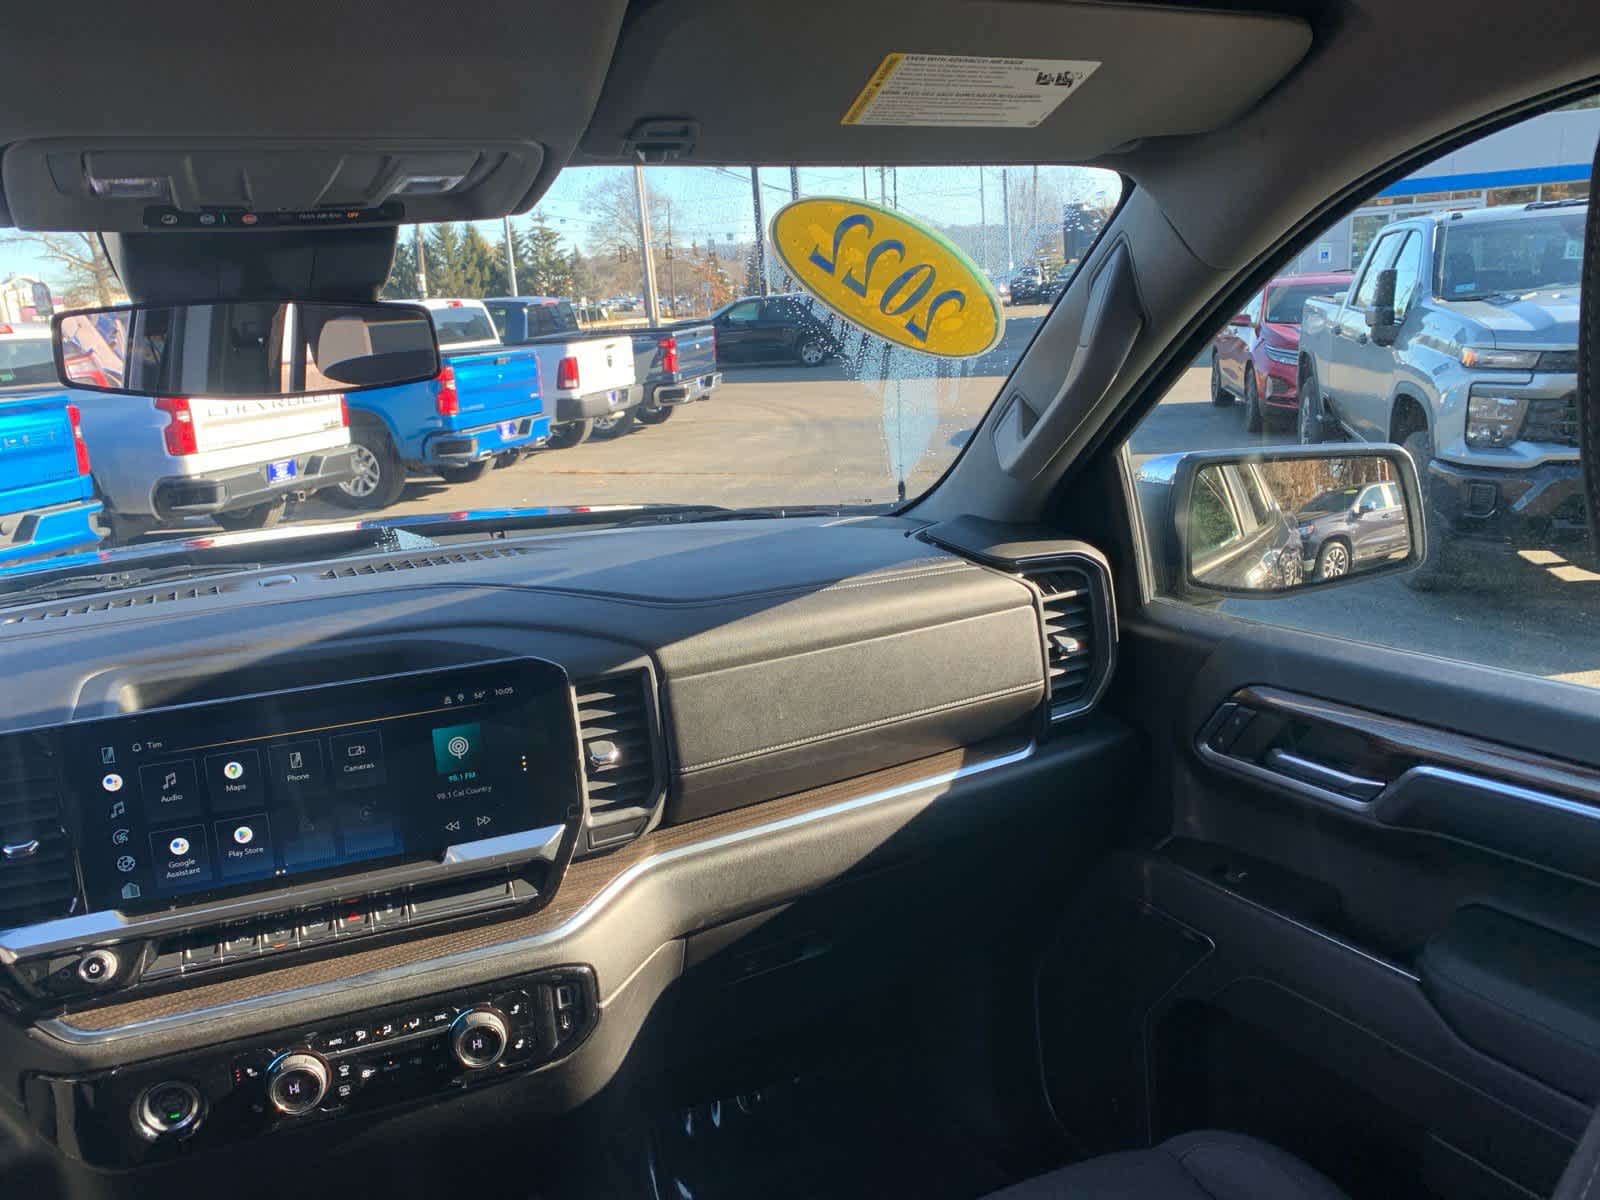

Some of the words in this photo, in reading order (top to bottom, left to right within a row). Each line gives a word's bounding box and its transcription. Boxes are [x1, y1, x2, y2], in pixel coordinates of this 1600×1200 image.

[147, 740, 162, 749] Tim
[343, 762, 375, 772] Cameras
[287, 773, 310, 782] Phone
[226, 784, 247, 792] Maps
[466, 785, 492, 795] Country
[161, 793, 183, 803] Audio
[229, 850, 244, 858] Play
[244, 847, 264, 856] Store
[168, 858, 195, 869] Google
[166, 867, 201, 878] Assistant
[328, 1038, 343, 1046] AUTO
